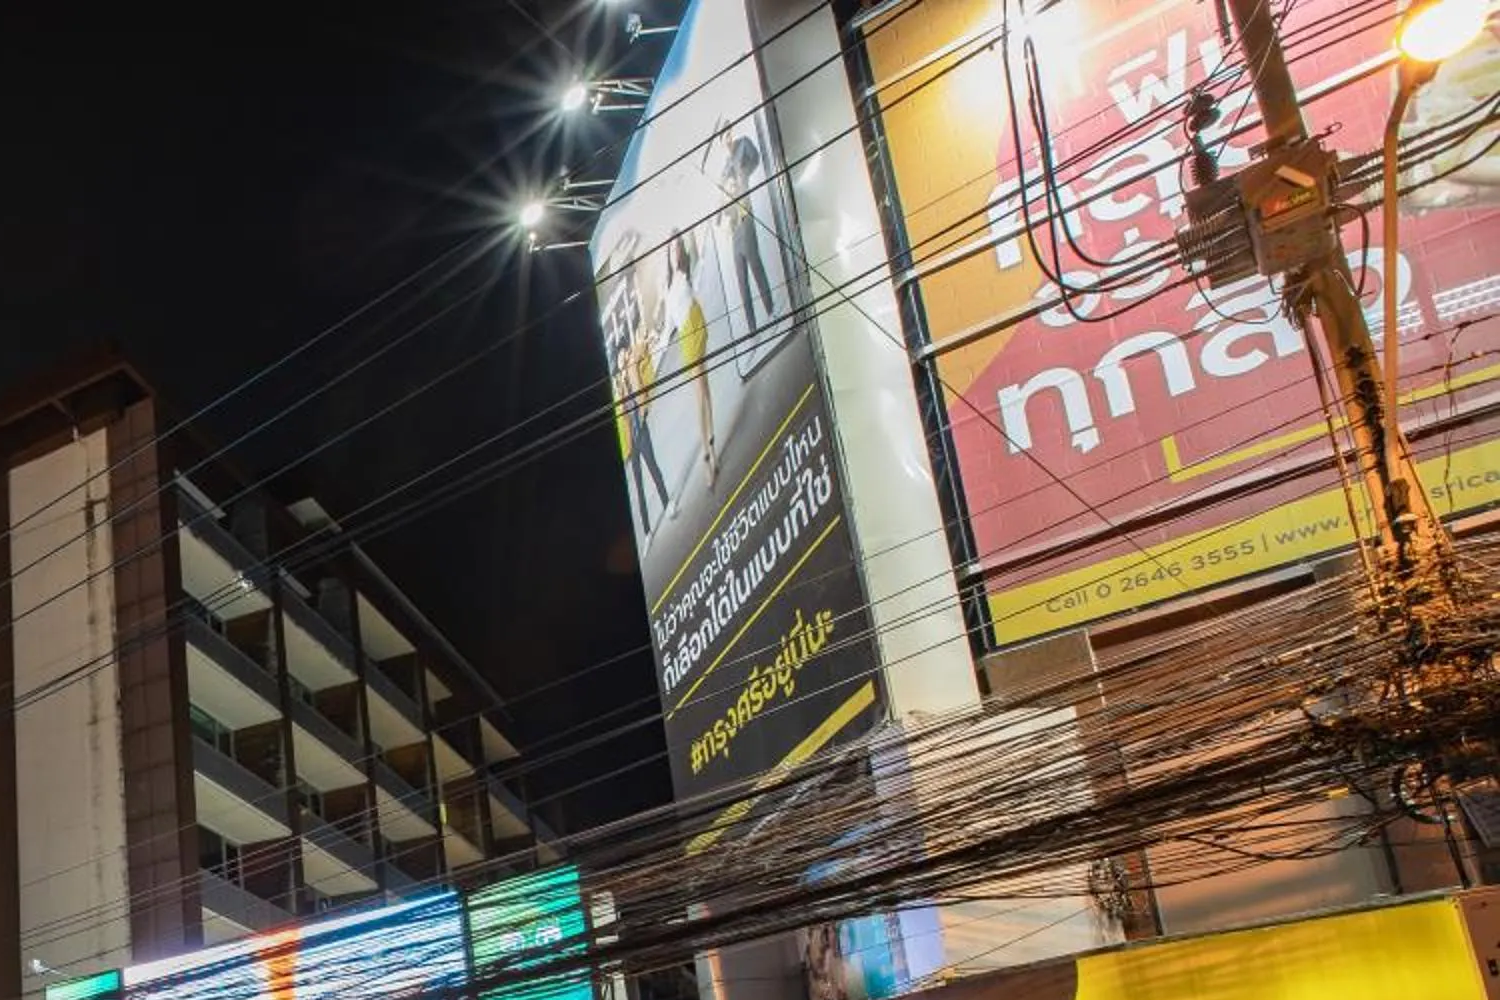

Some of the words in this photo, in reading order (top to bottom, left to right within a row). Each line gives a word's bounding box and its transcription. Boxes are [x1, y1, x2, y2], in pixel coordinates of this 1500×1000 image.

[1045, 590, 1089, 613] Call
[1120, 561, 1183, 593] 2646
[1190, 538, 1256, 571] 3555
